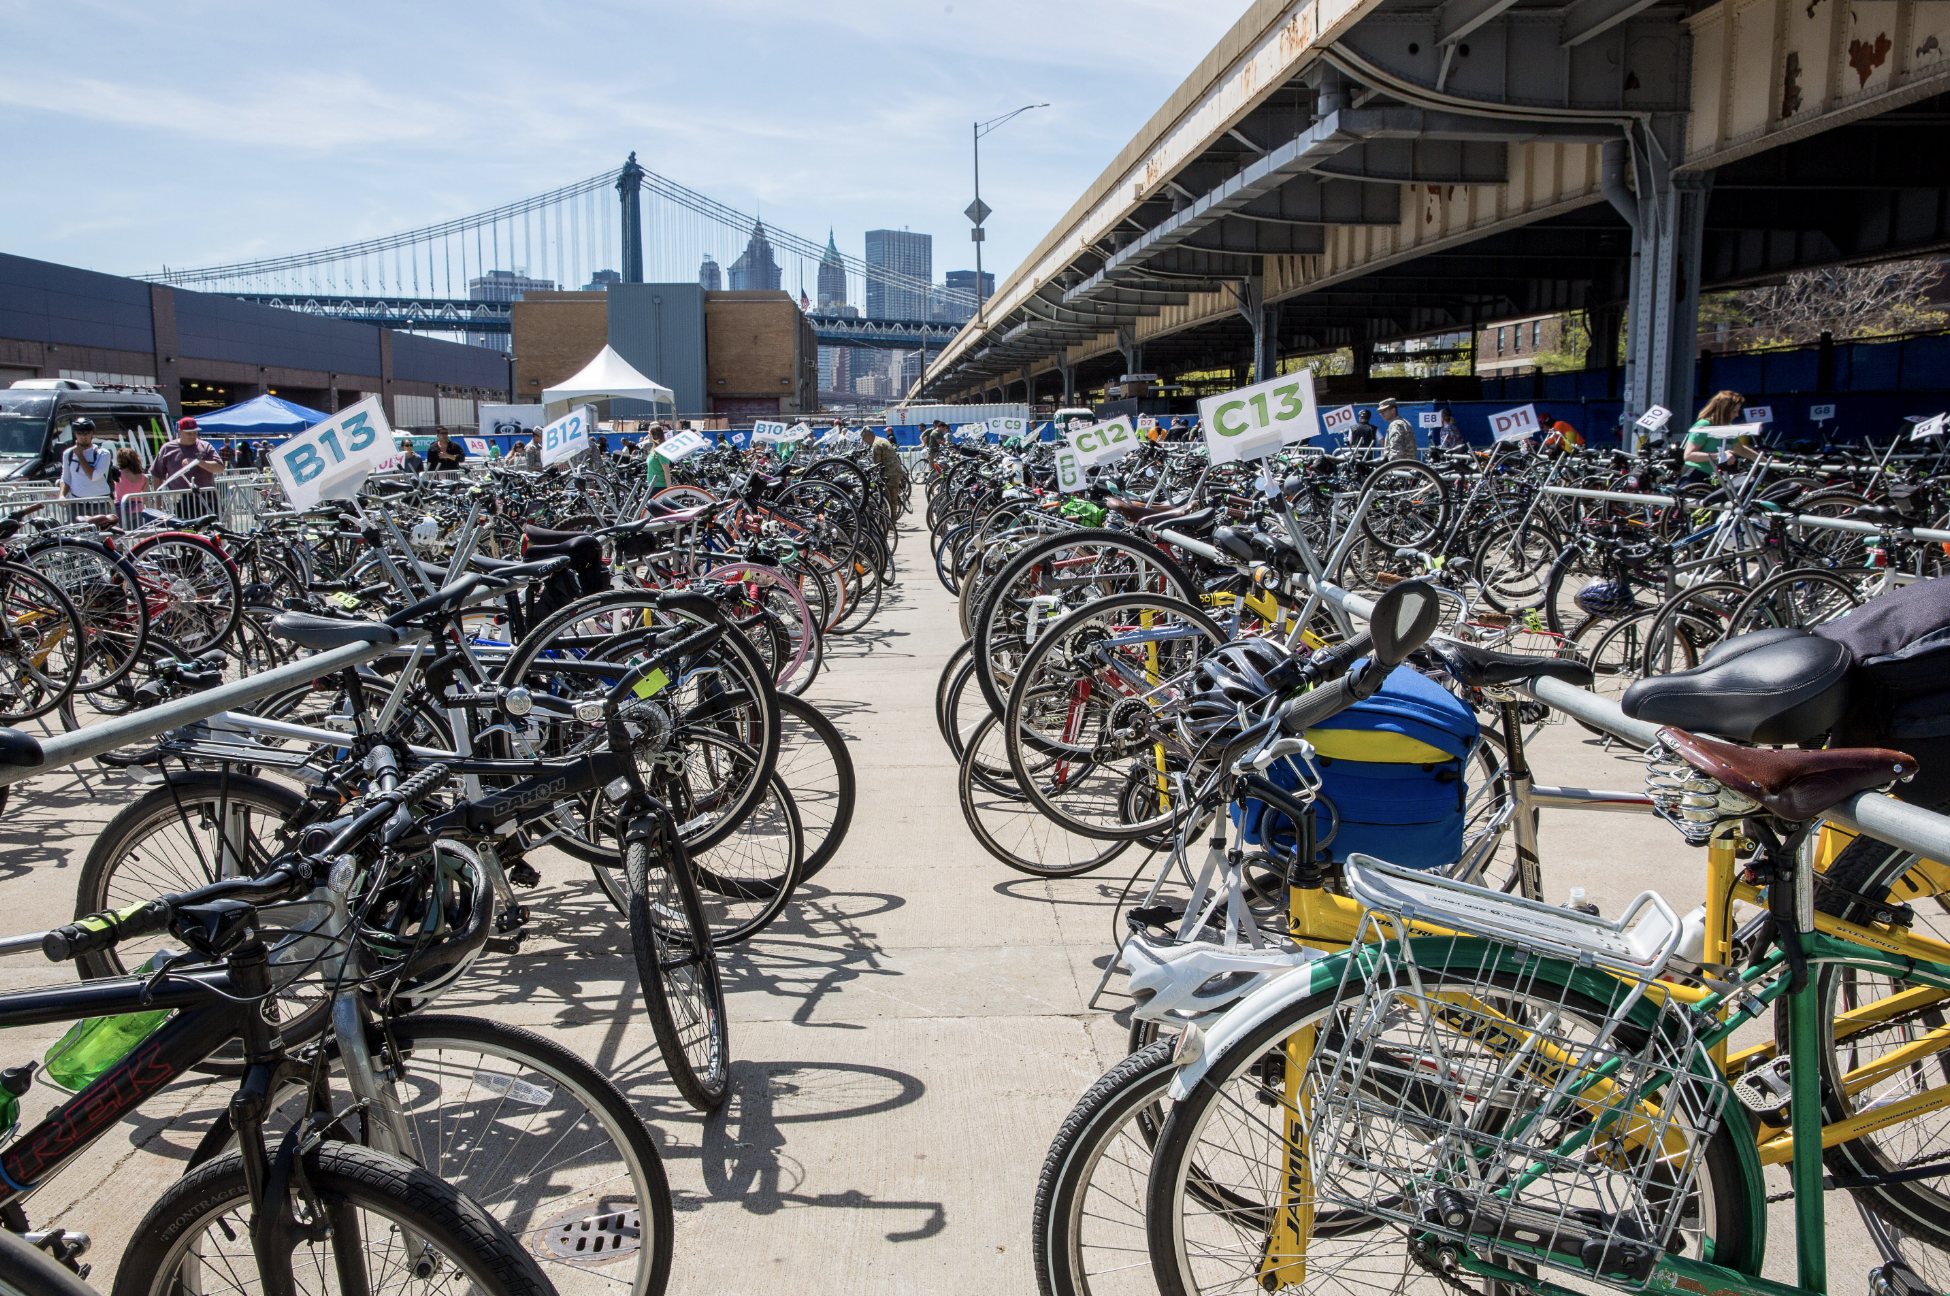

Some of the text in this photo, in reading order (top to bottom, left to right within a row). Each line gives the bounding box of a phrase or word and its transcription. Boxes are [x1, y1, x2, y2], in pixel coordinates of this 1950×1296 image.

[1213, 382, 1303, 437] C13
[1325, 409, 1352, 427] D10
[1423, 414, 1437, 422] E8
[1641, 409, 1663, 426] E10
[1750, 408, 1766, 418] F9
[1814, 406, 1831, 415] G8
[755, 423, 783, 435] B10
[972, 424, 983, 435] C7
[992, 420, 1001, 428] C
[1004, 420, 1022, 430] C9
[1495, 410, 1530, 432] D11
[471, 440, 485, 450] A9
[546, 416, 582, 452] B12
[662, 434, 694, 453] B11
[1076, 424, 1129, 452] C12
[284, 411, 376, 487] B13
[1060, 454, 1077, 487] C11
[1510, 709, 1521, 754] BONTRAGER
[494, 777, 566, 817] DAHON
[1836, 926, 1899, 951] SEVEN-SPEED
[1853, 1099, 1943, 1132] WWW.JAMISBIKES.COM
[1287, 1118, 1304, 1246] JAMIS
[168, 1185, 249, 1237] BONTRAGER
